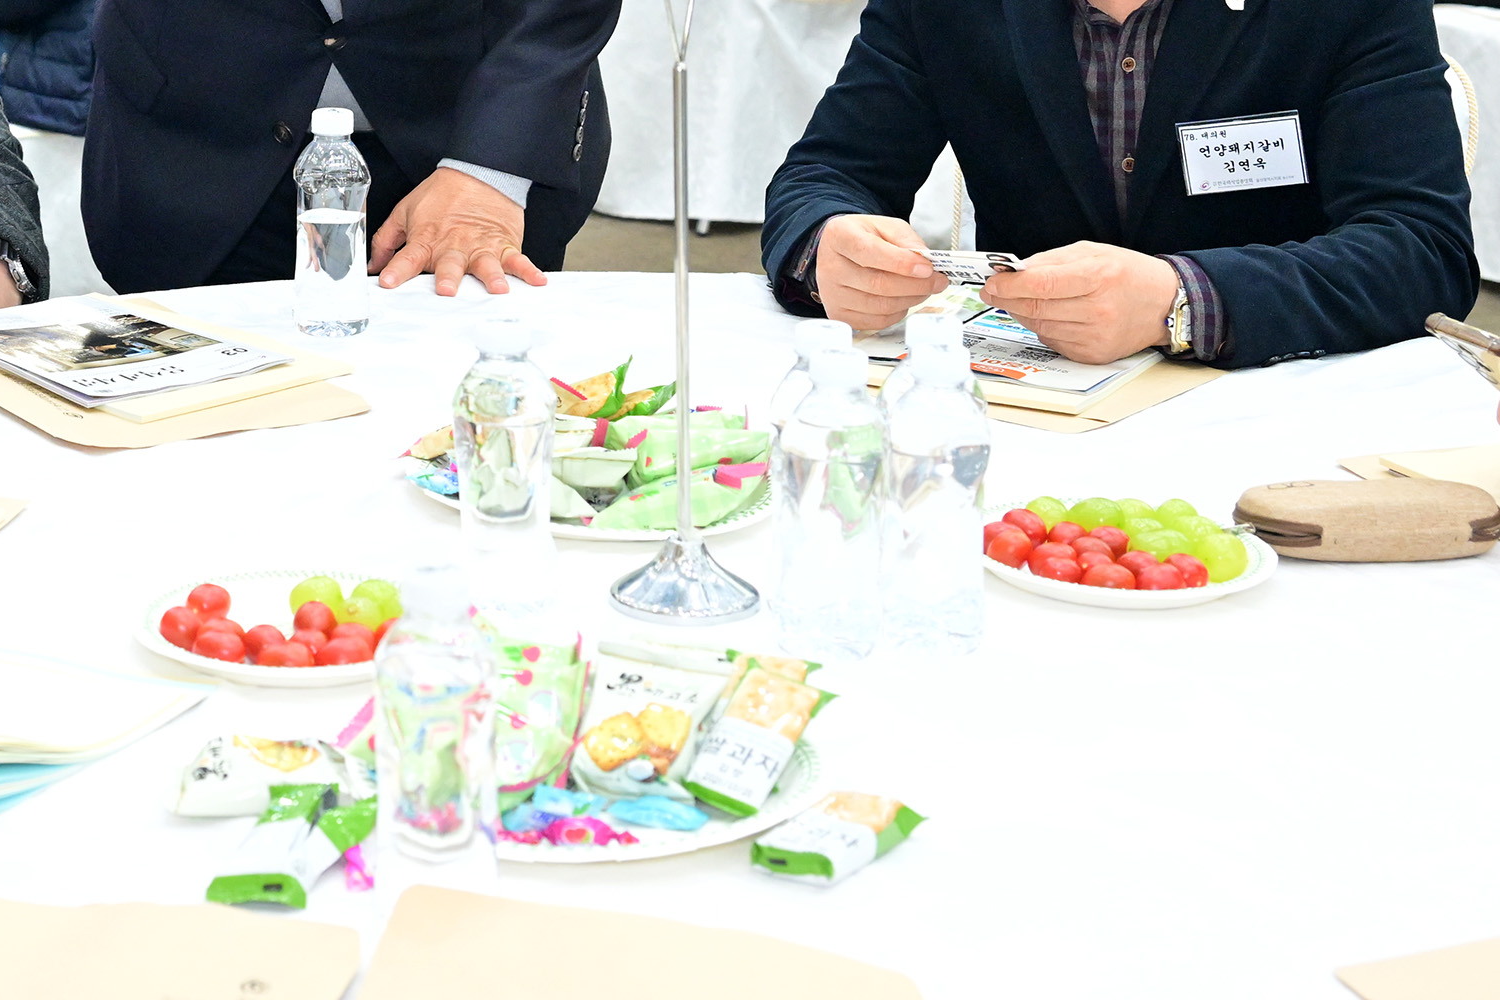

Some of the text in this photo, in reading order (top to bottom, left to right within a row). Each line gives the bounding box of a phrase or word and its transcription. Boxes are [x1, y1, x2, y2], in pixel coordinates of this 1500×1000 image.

[1201, 129, 1227, 139] 대의원
[1199, 137, 1285, 159] 언양돼지갈비
[1223, 157, 1267, 173] 김연옥
